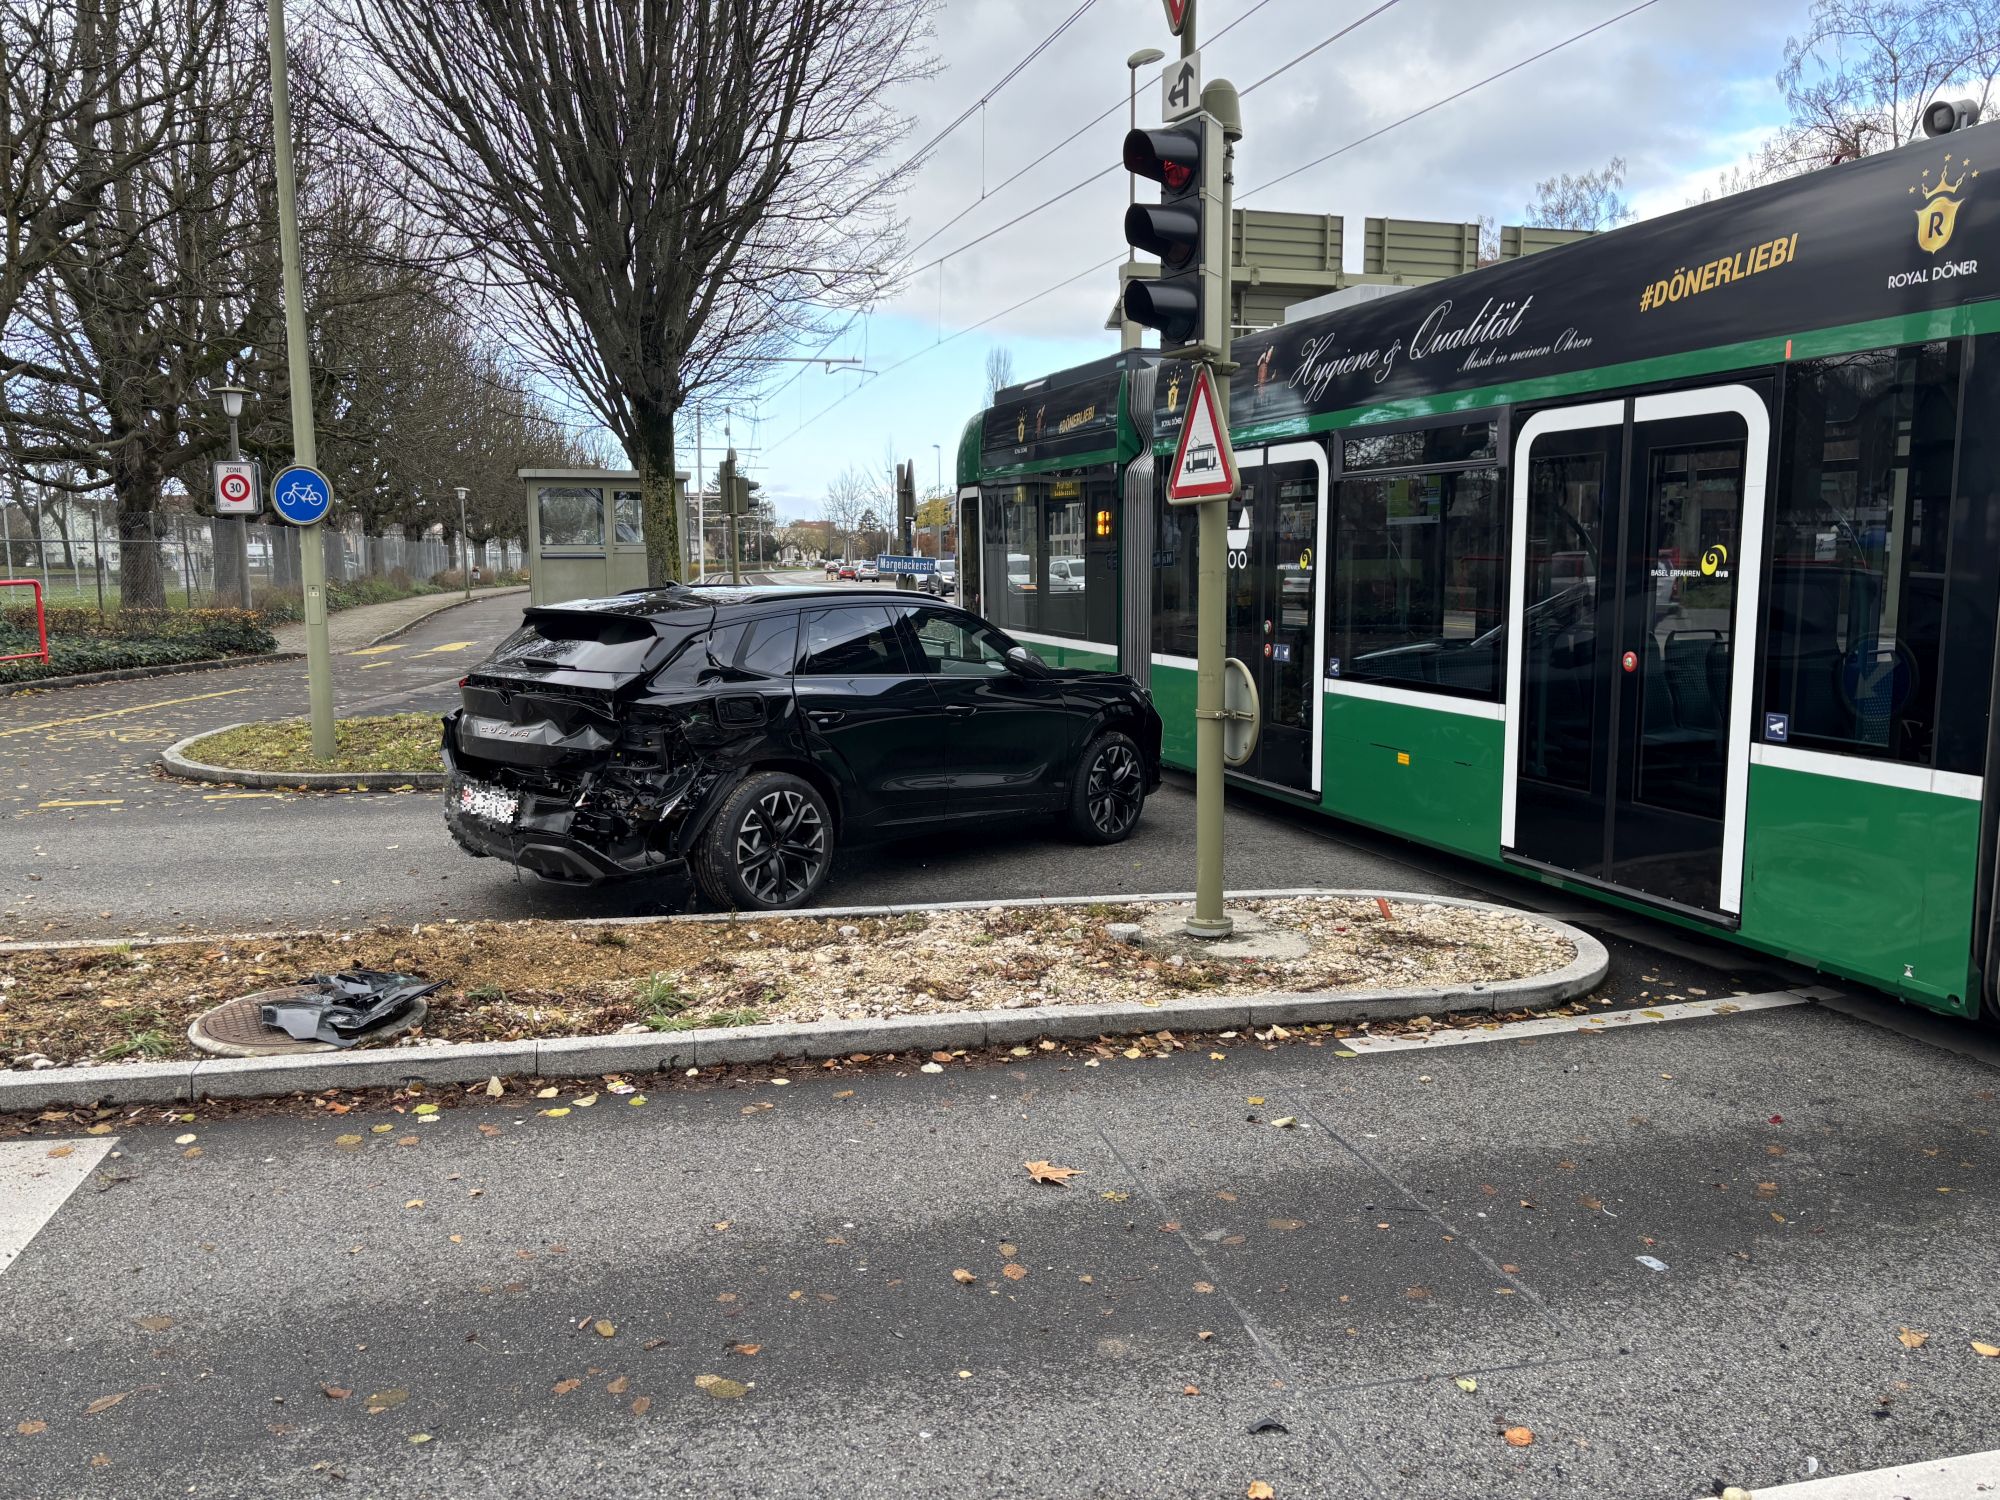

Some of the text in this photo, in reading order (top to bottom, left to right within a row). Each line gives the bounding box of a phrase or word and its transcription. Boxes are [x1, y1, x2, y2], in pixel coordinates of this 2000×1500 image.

[1928, 211, 1943, 239] R
[1640, 232, 1799, 312] #DÖNERLIEBI
[1887, 259, 1978, 289] ROYAL DÖNER
[1288, 332, 1380, 404] Hygiene
[1409, 294, 1534, 361] Qualität
[1456, 327, 1594, 375] Musik in meinen Ohren
[229, 483, 241, 493] 30
[1650, 569, 1729, 578] BASEL ERFAHREN BVB
